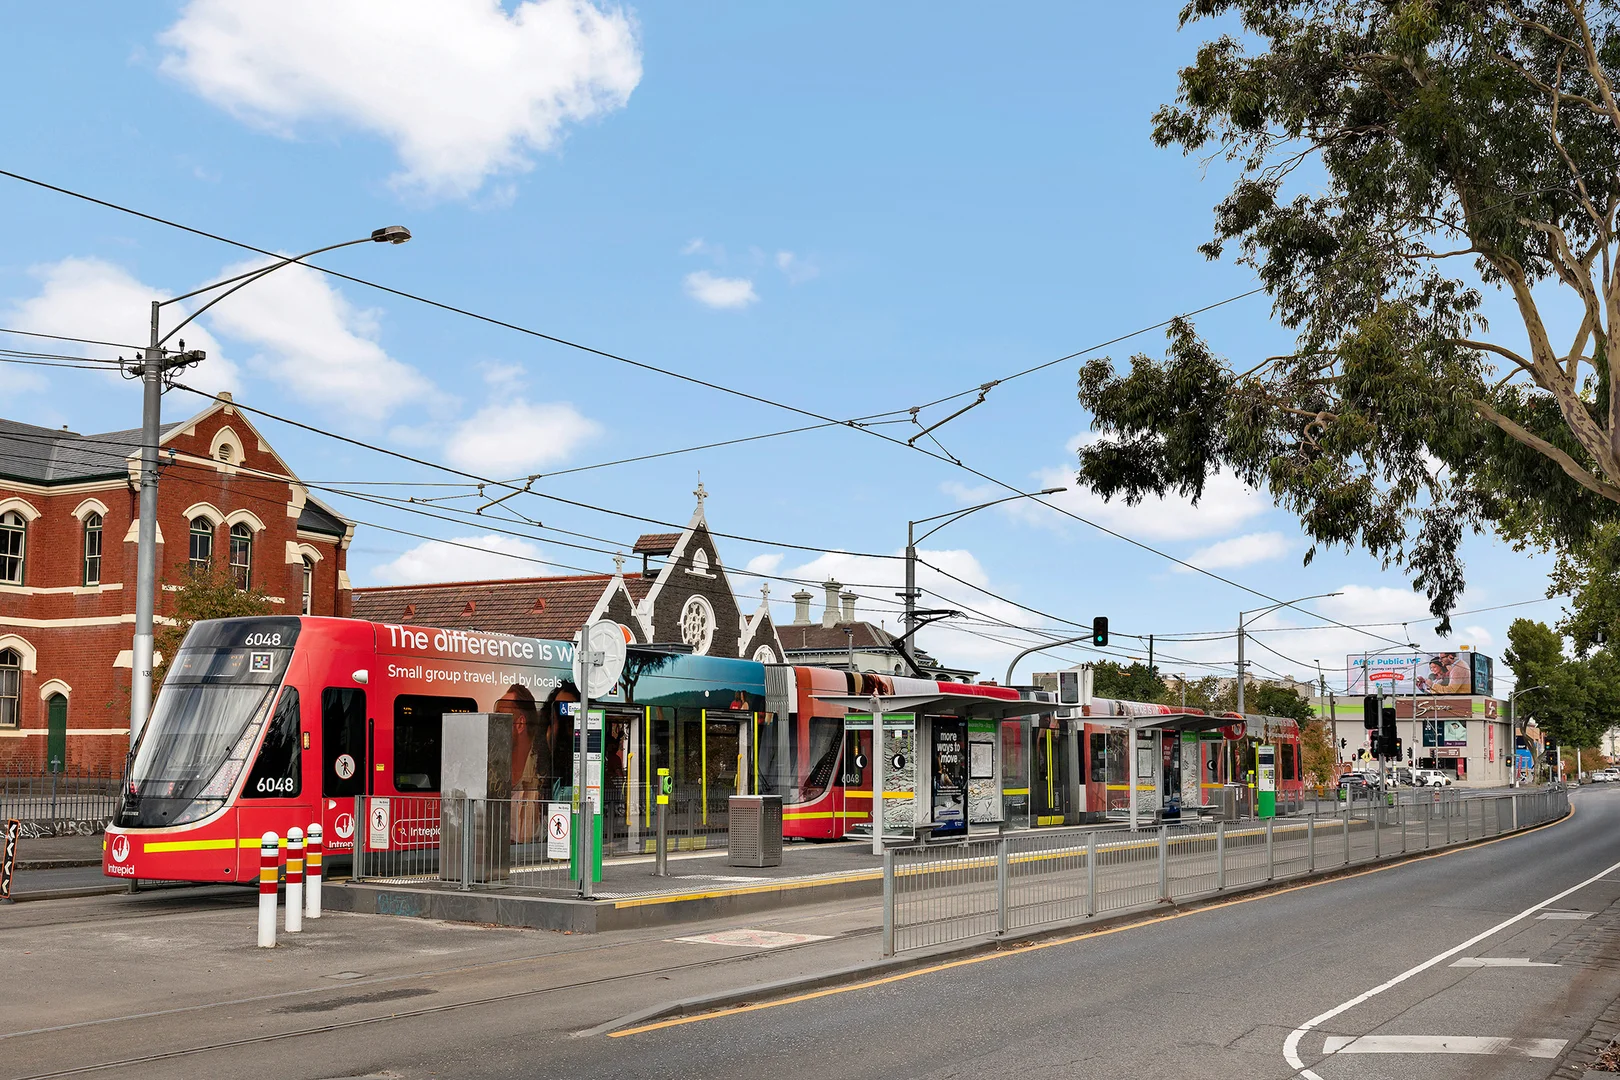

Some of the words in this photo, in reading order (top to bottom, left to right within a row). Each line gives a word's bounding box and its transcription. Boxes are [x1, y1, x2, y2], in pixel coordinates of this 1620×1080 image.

[244, 632, 282, 646] 6048
[384, 624, 429, 650] The
[433, 629, 534, 659] difference
[537, 639, 553, 661] is
[1352, 658, 1375, 666] Afer
[1377, 657, 1404, 666] Public
[1406, 657, 1421, 665] IVF
[387, 663, 423, 679] Small
[425, 668, 461, 683] group
[463, 670, 498, 687] travel,
[499, 671, 518, 684] led
[518, 674, 532, 688] by
[533, 675, 562, 689] locals
[940, 732, 958, 742] more
[936, 743, 953, 755] ways
[954, 741, 961, 752] to
[256, 777, 294, 792] 6048
[841, 773, 859, 783] 6048
[328, 840, 354, 850] Intrep
[107, 863, 135, 877] Intrepid
